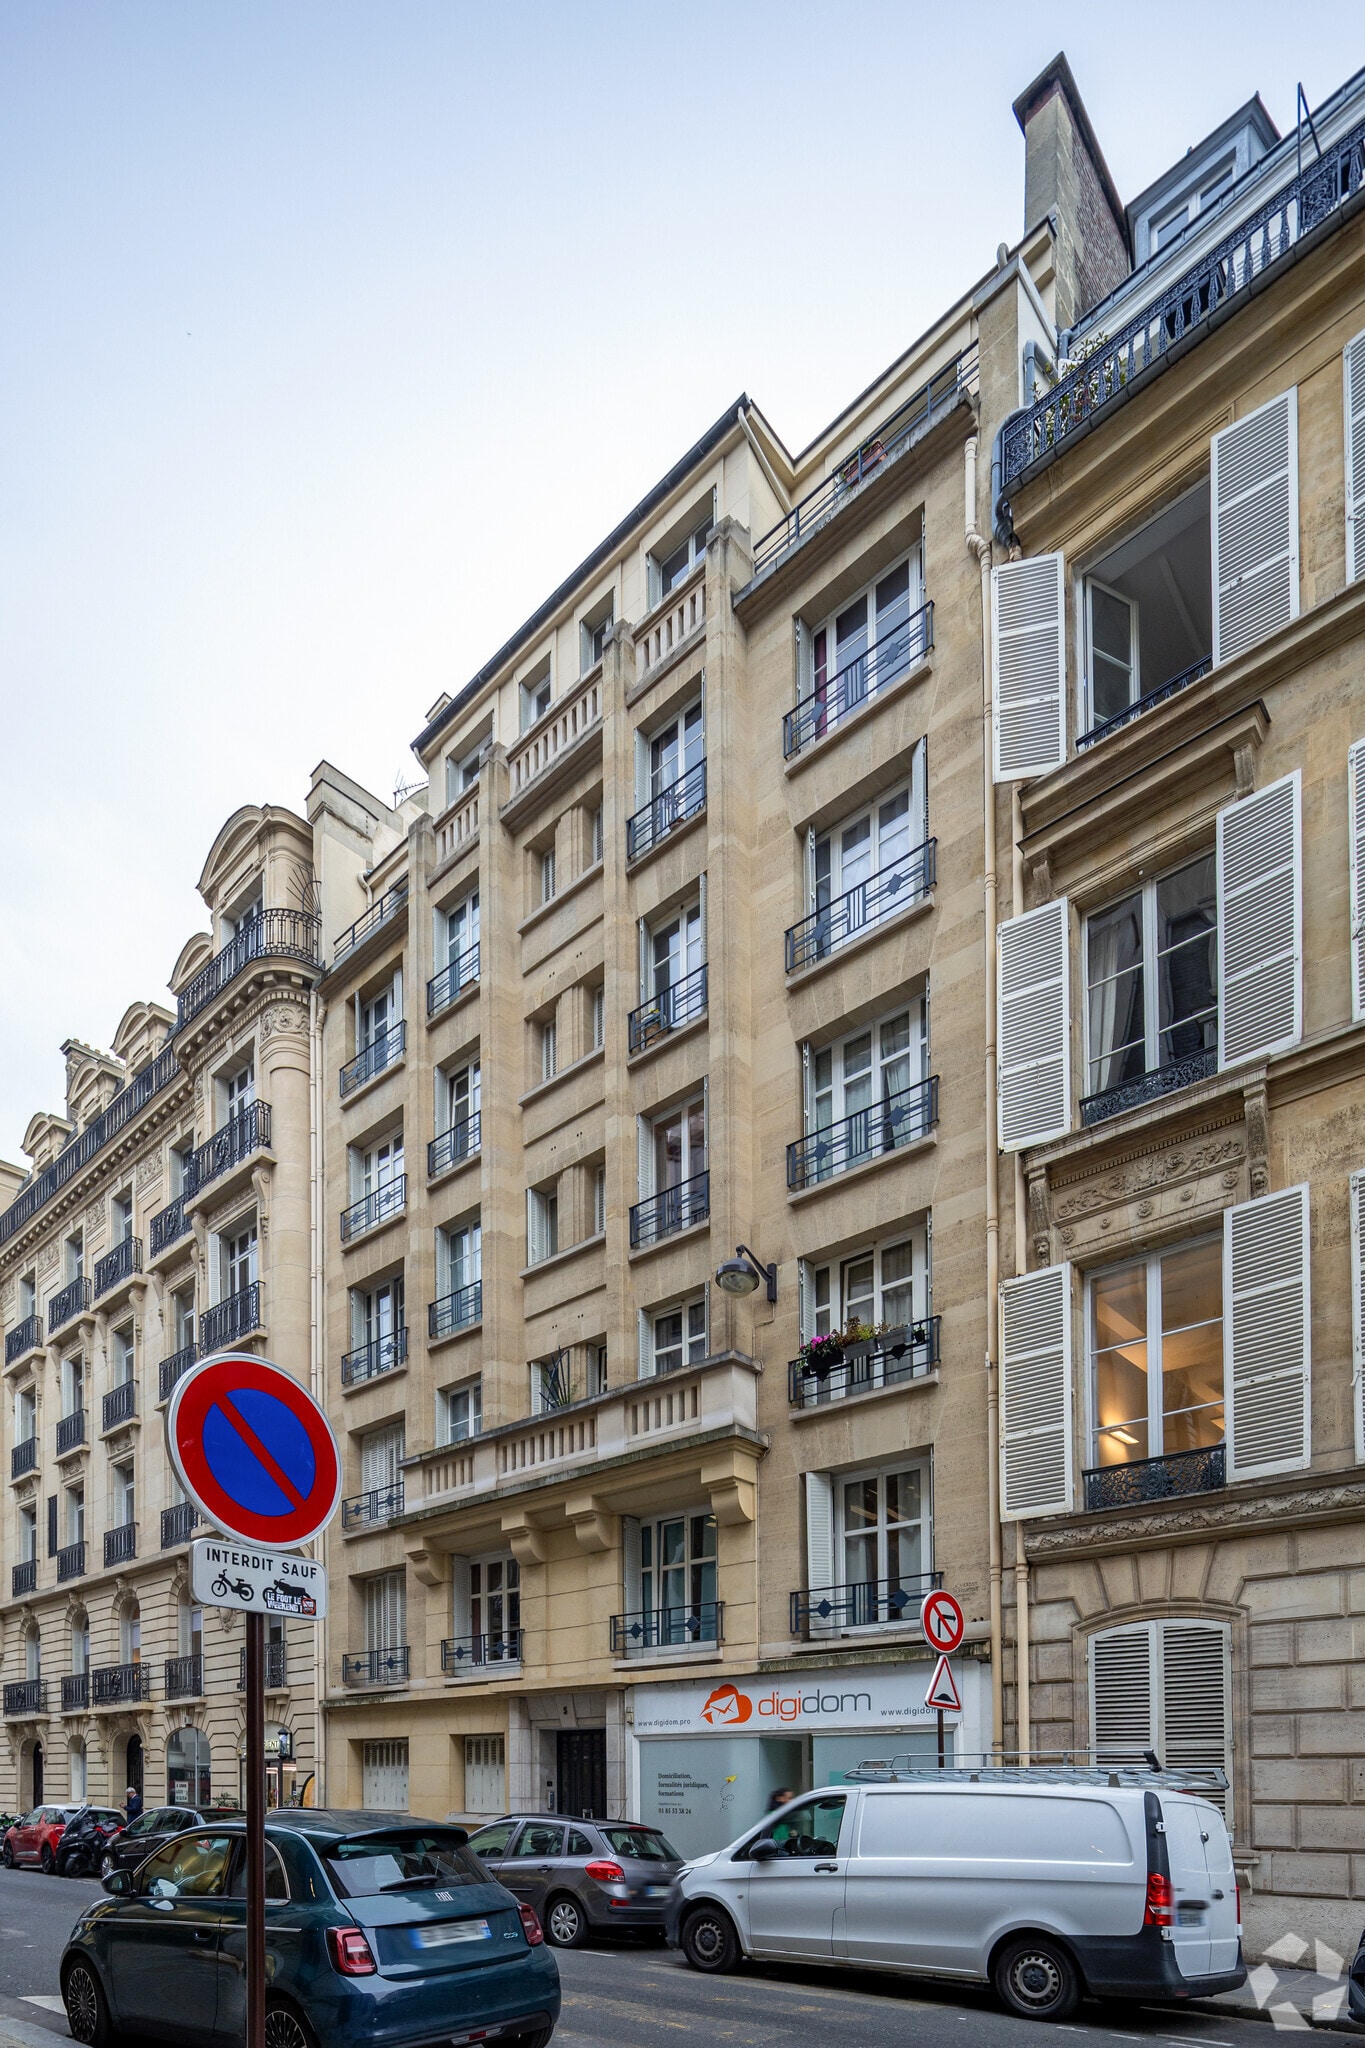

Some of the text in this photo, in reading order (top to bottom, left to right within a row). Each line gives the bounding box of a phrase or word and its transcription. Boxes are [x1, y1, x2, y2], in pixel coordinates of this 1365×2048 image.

[206, 1547, 317, 1579] INTERDIT SAUF
[267, 1592, 302, 1605] LE FOOT LE
[267, 1600, 299, 1612] WEEKEND
[758, 1688, 872, 1722] digidom
[637, 1718, 691, 1728] www.digidom.pro
[434, 1891, 455, 1902] FIAT
